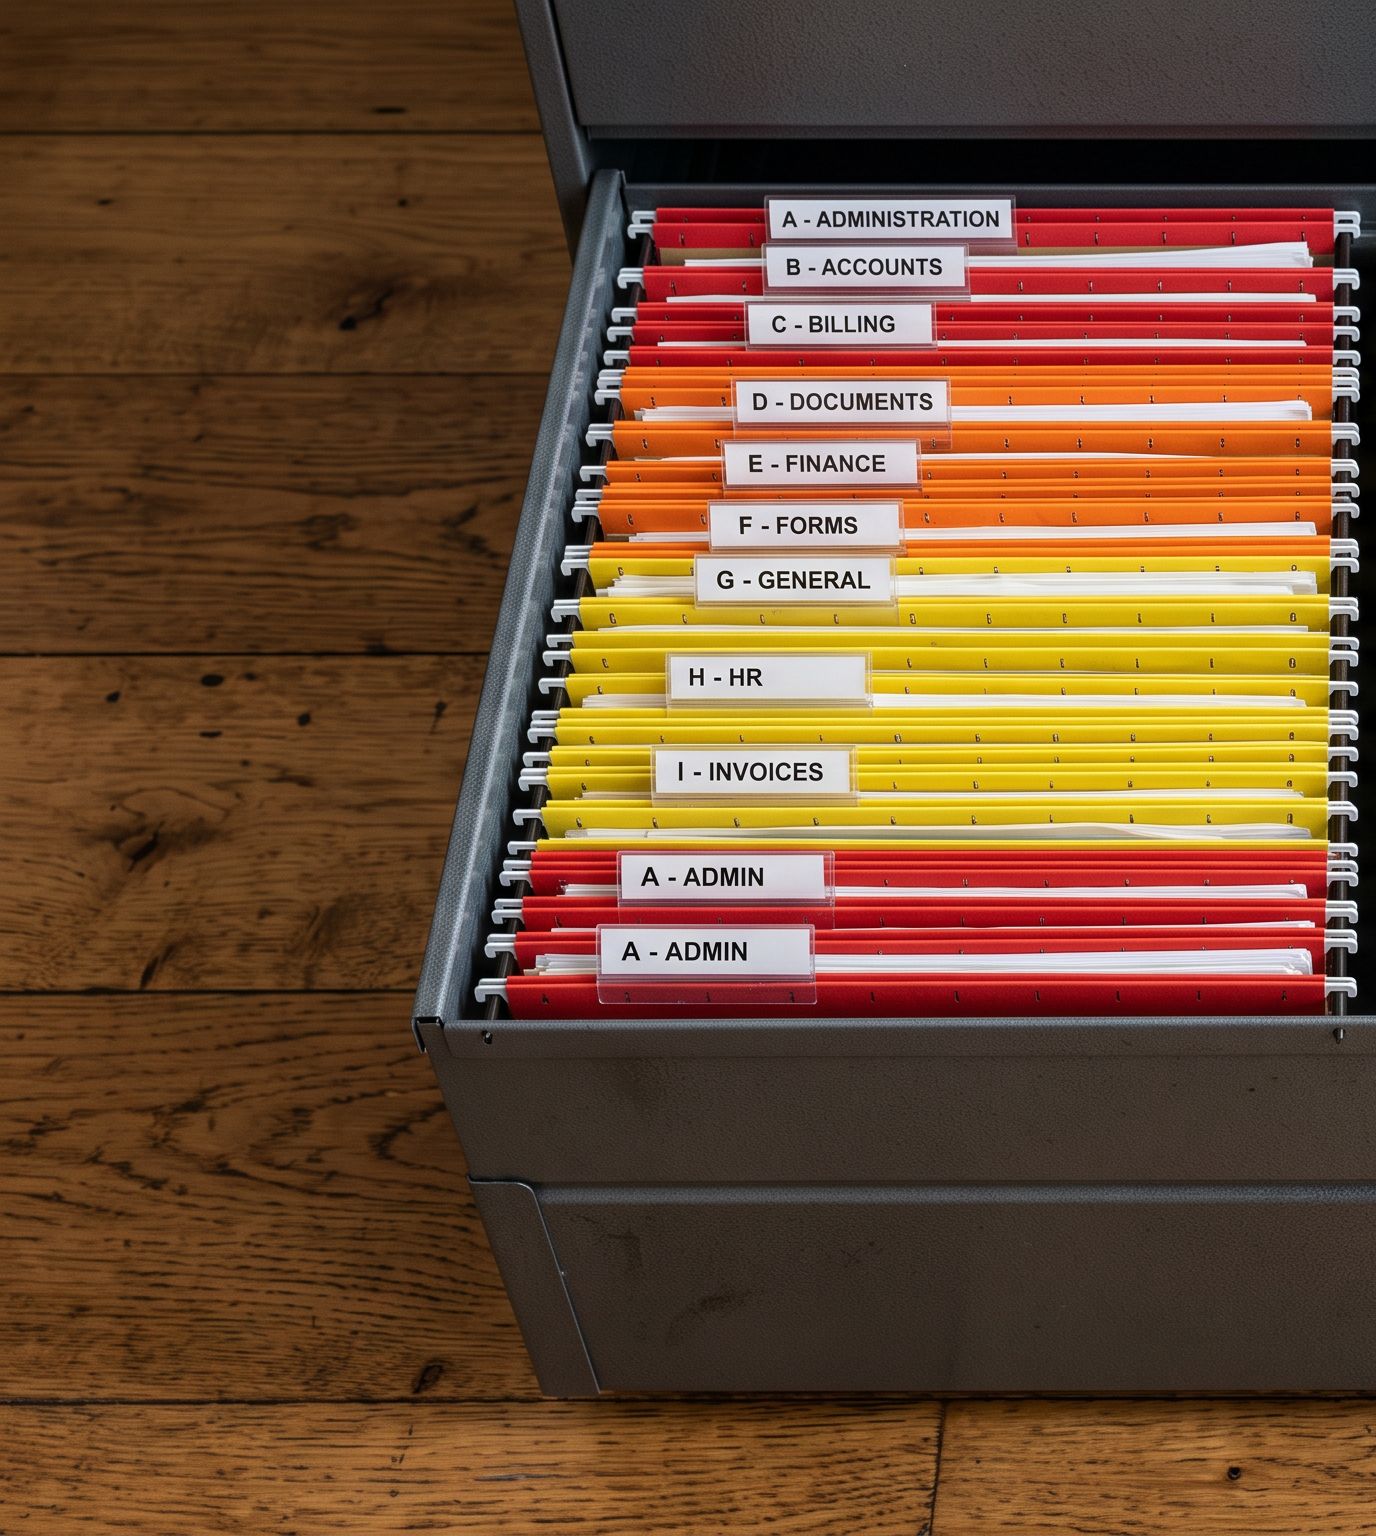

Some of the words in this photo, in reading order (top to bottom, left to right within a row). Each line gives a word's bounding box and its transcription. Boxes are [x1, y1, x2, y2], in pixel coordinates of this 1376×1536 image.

[781, 210, 798, 228] A
[816, 210, 1000, 228] ADMINISTRATION
[786, 258, 801, 276] B
[821, 257, 943, 276] ACCOUNTS
[771, 315, 787, 334] C
[808, 314, 896, 333] BILLING
[752, 392, 768, 411] D
[790, 392, 933, 411] DOCUMENTS
[748, 454, 763, 473] E
[785, 454, 886, 473] FINANCE
[739, 515, 753, 535] F
[776, 516, 858, 535] FORMS
[716, 570, 734, 590] G
[758, 570, 871, 590] GENERAL
[689, 667, 705, 687] H
[729, 667, 763, 687] HR
[709, 762, 824, 782] INVOICES
[640, 866, 660, 887] A
[682, 867, 764, 887] ADMIN
[621, 941, 641, 962] A
[664, 941, 748, 962] ADMIN
